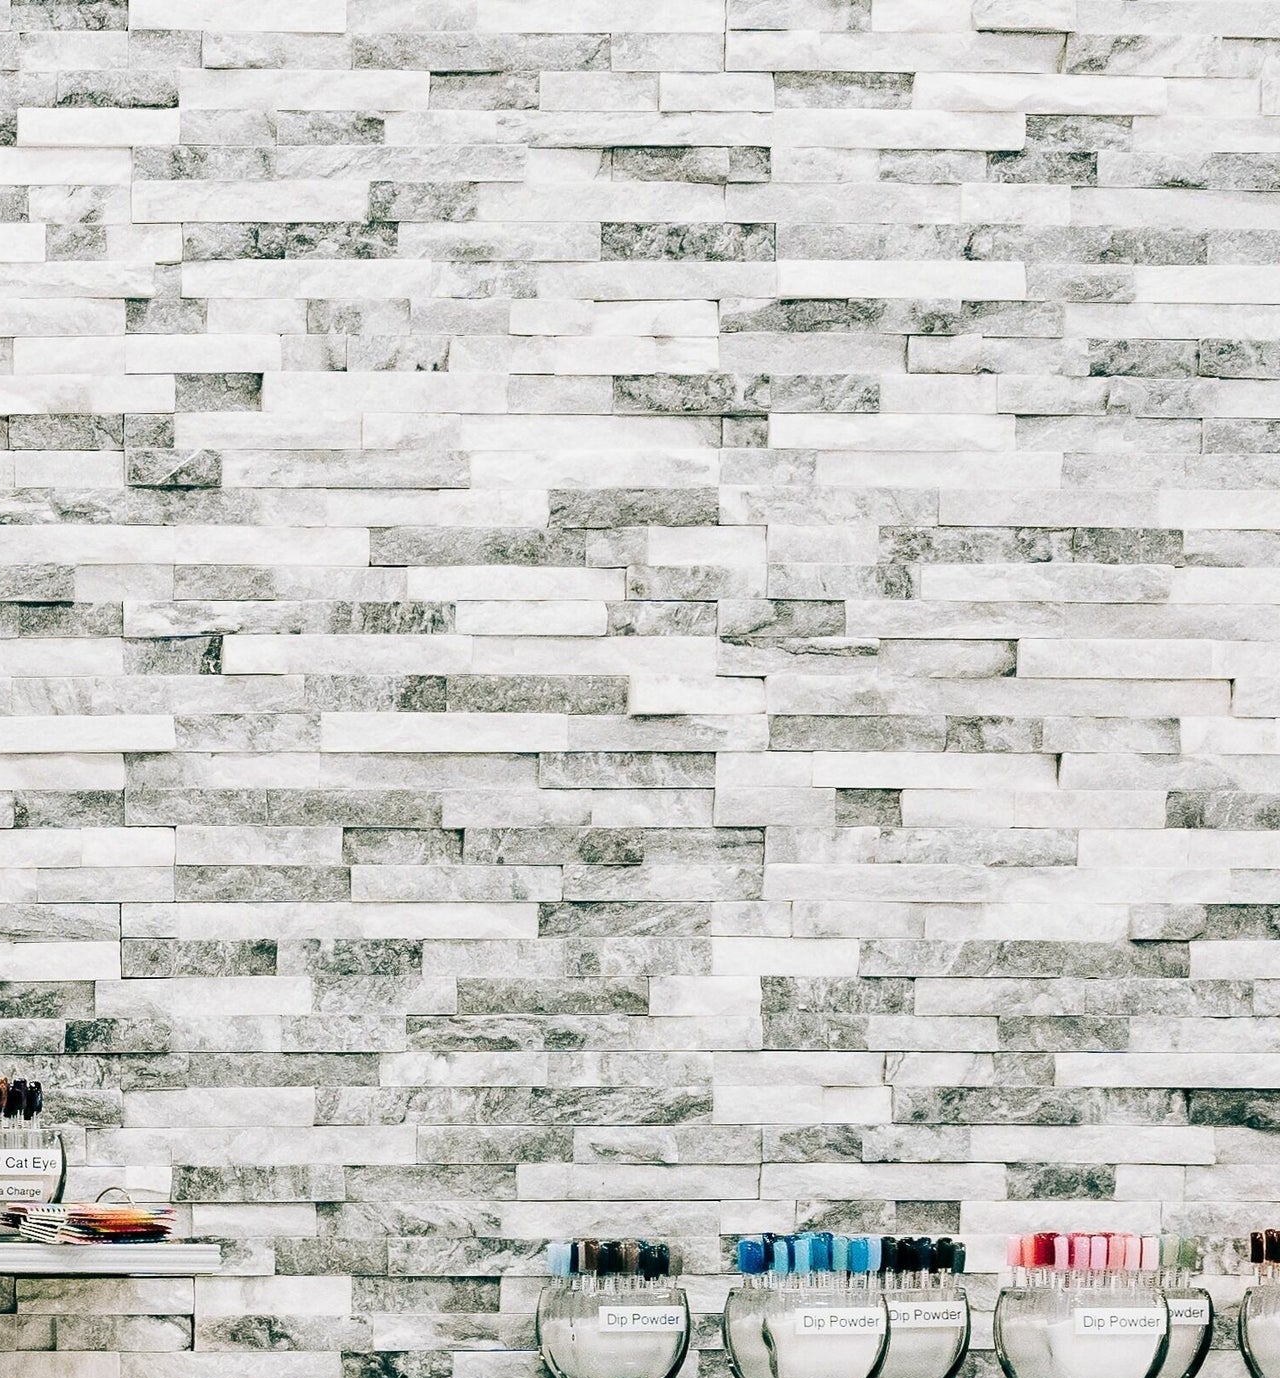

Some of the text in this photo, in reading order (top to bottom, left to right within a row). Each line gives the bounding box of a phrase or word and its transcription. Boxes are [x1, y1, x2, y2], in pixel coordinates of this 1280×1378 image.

[4, 1156, 29, 1170] Cat
[31, 1156, 58, 1173] Eye
[5, 1186, 42, 1199] Charge
[606, 1312, 681, 1329] Dip Powder
[913, 1307, 963, 1322] Powder
[1169, 1307, 1205, 1320] owder
[803, 1314, 881, 1331] Dip Powder
[1083, 1314, 1161, 1331] Dip Powder
